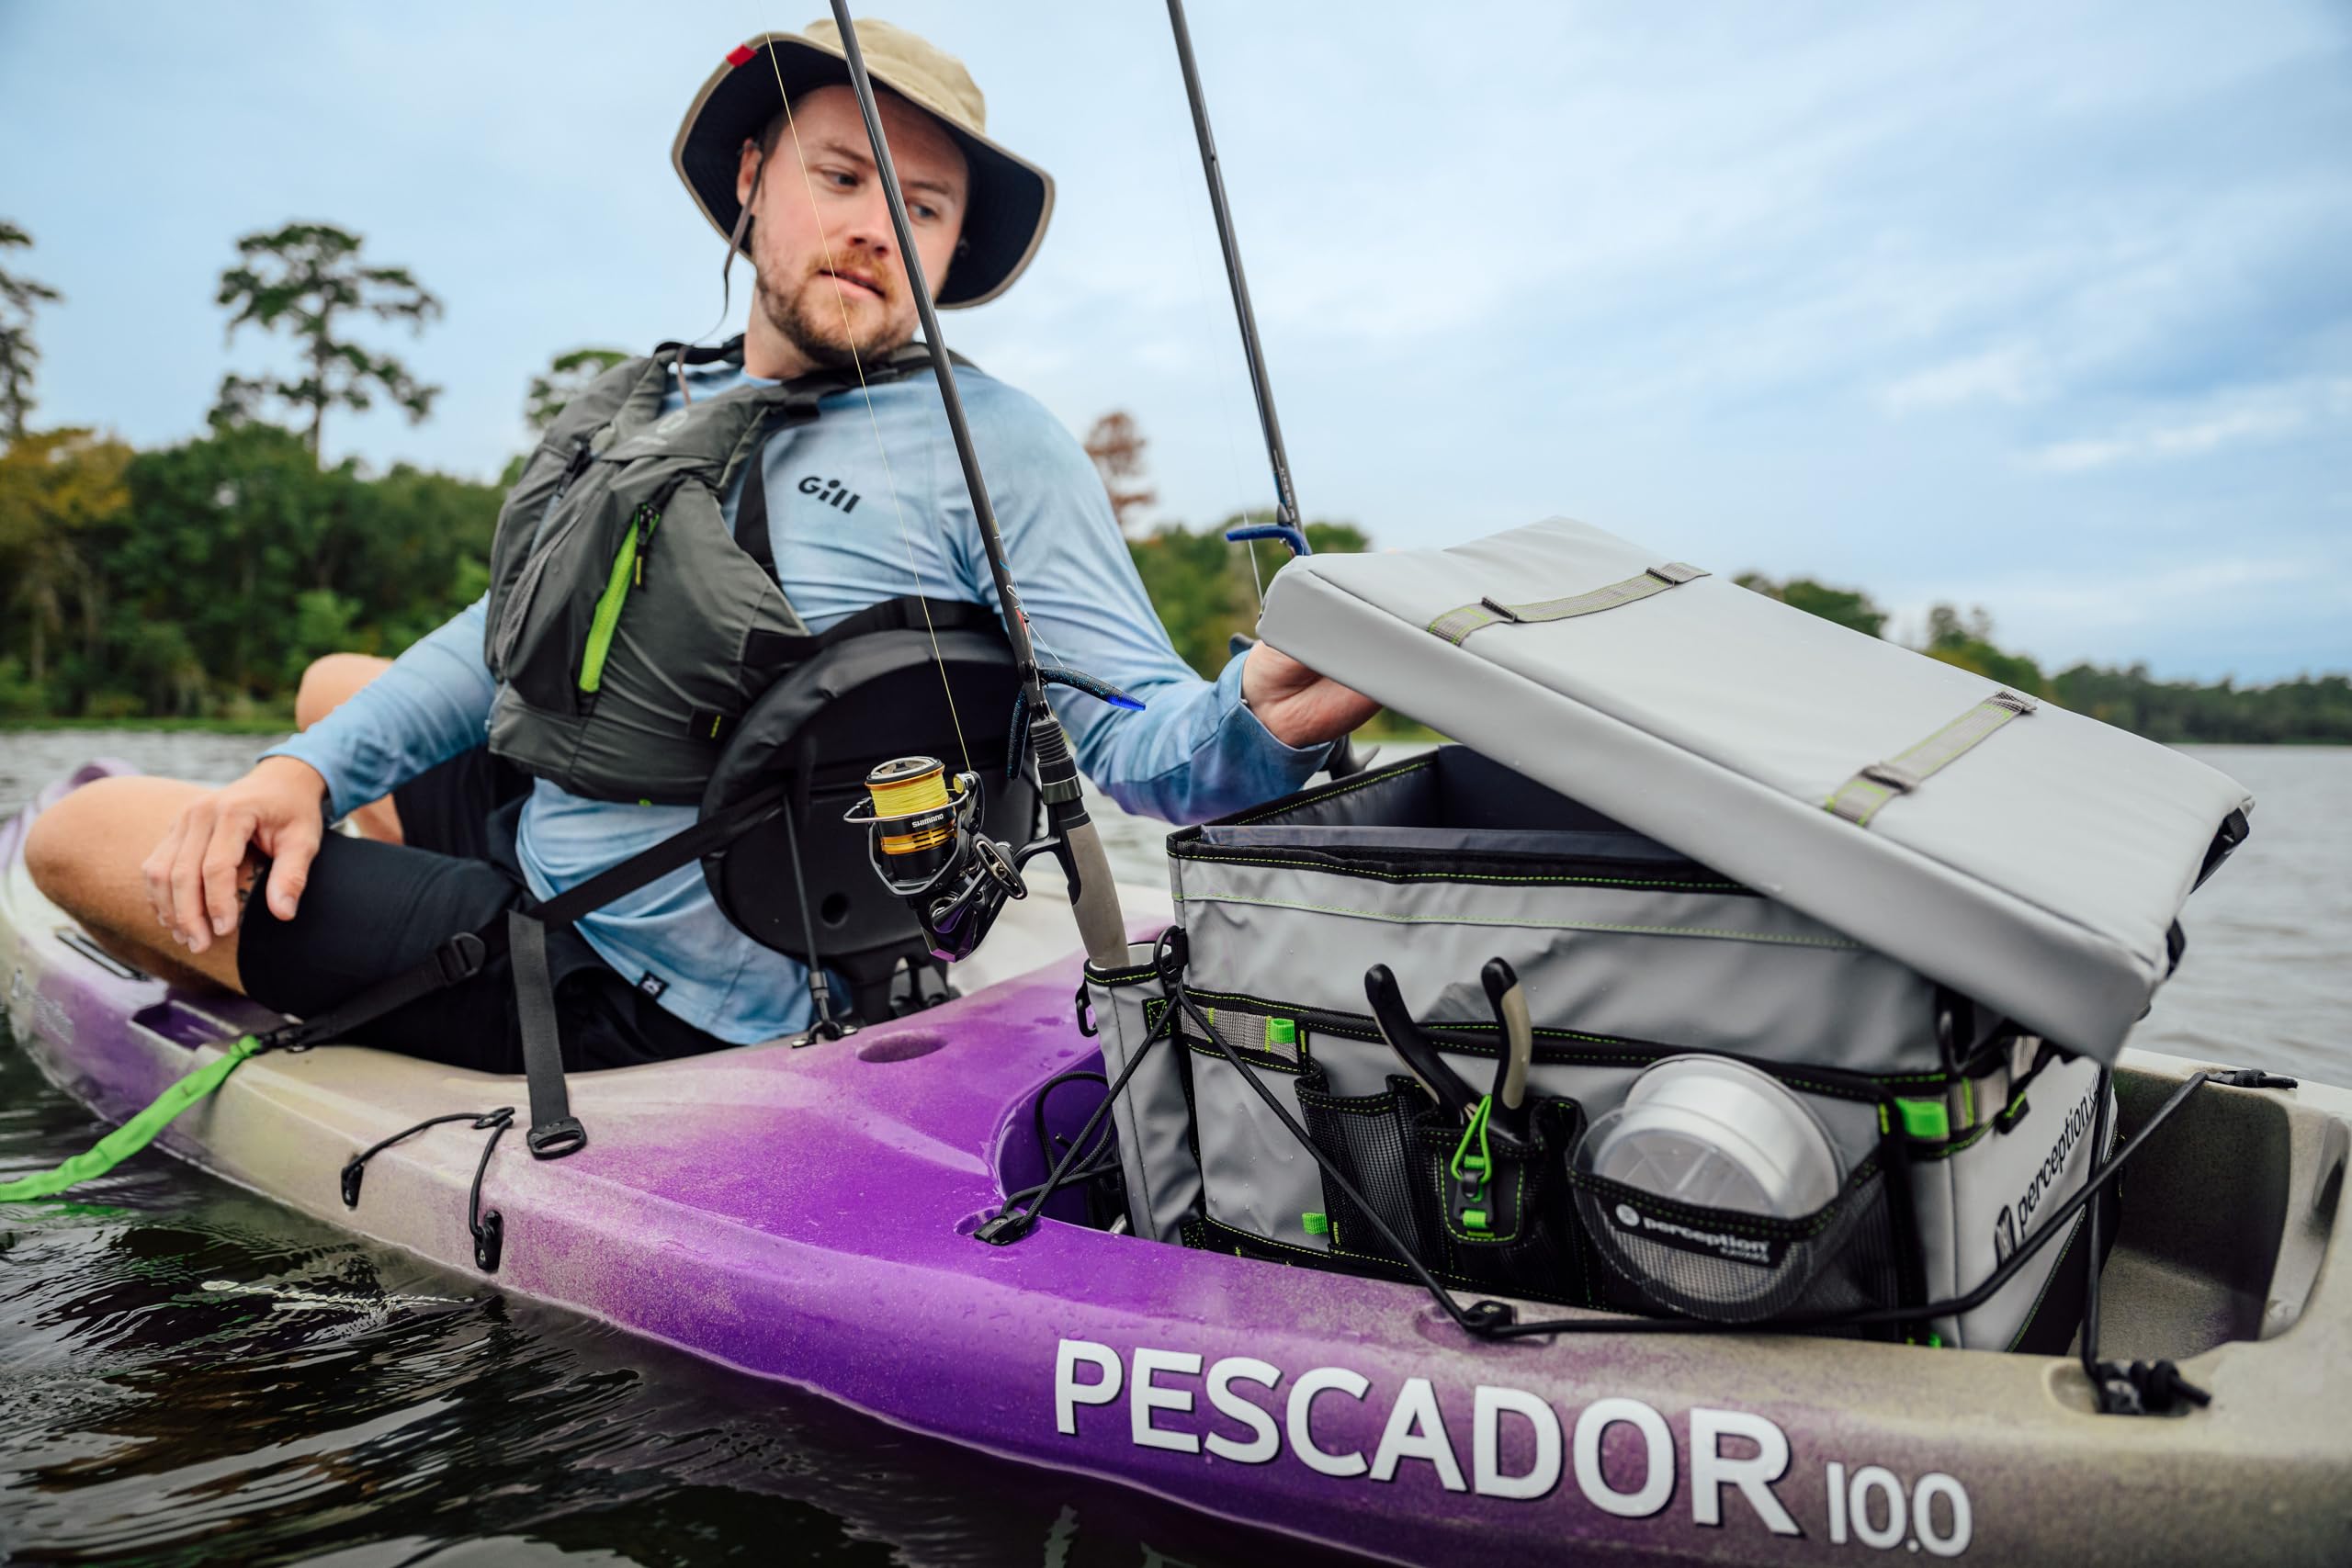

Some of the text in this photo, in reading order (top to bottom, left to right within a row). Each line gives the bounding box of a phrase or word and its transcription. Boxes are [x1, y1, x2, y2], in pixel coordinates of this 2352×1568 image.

[797, 476, 861, 513] Gill
[911, 813, 944, 828] SHIMANO
[2018, 1096, 2089, 1239] perception
[1643, 1216, 1769, 1253] perception
[1055, 1338, 1973, 1558] PESCADOR 10.0
